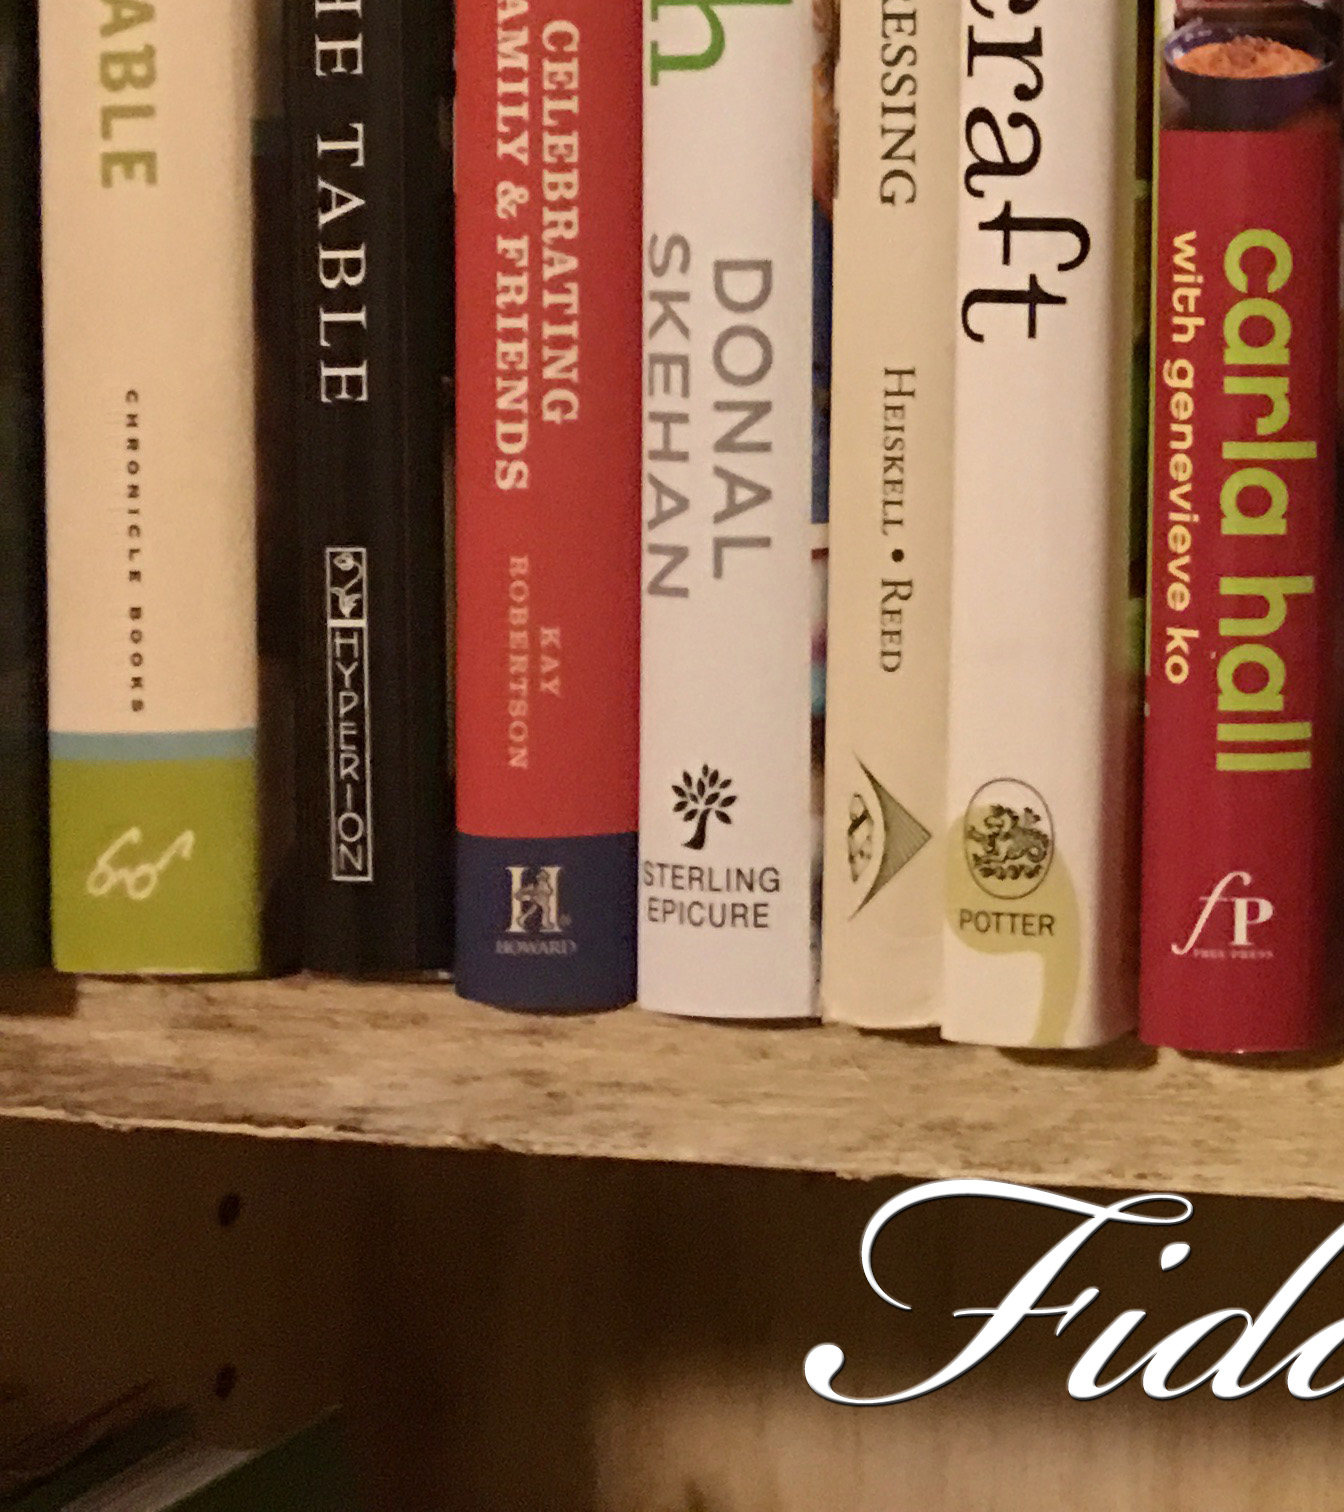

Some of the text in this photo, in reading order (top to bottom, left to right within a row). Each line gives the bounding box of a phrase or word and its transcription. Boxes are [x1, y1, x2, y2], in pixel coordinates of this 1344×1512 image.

[317, 122, 368, 404] TABLE
[495, 180, 529, 219] &
[541, 19, 581, 426] CELEBRATING
[495, 235, 530, 491] FRIENDS
[646, 233, 692, 598] SKEHAN
[712, 258, 773, 579] DONAL
[1163, 230, 1205, 685] with genevieve ko
[124, 388, 146, 714] CHRONICLE BOOKS
[880, 366, 916, 673] HEISKELL REED
[1215, 227, 1317, 773] carla hall
[332, 630, 364, 872] HYPERION
[508, 555, 529, 770] ROBERTSON
[538, 626, 561, 698] KAY
[643, 859, 782, 894] STERLING
[647, 898, 770, 930] EPICURE
[960, 910, 1056, 937] POTTER
